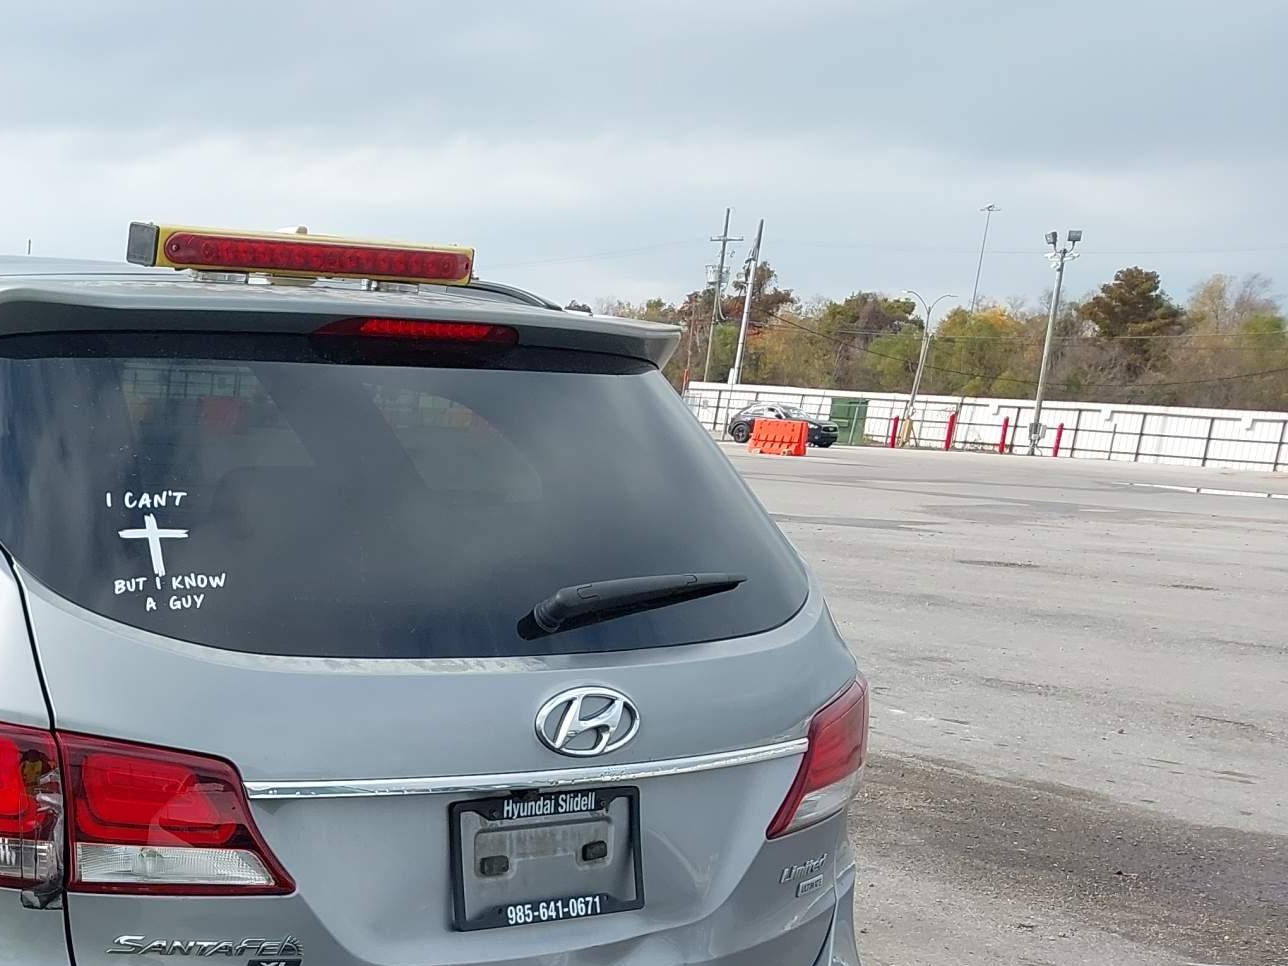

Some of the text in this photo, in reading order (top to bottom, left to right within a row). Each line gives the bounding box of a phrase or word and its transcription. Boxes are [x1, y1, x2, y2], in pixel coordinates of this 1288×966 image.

[106, 490, 187, 508] I CAN'T
[114, 573, 226, 594] BUT I KNOW
[146, 594, 204, 611] A GUY
[503, 791, 596, 820] Hyundai Slidell
[507, 895, 601, 925] 985-641-0671
